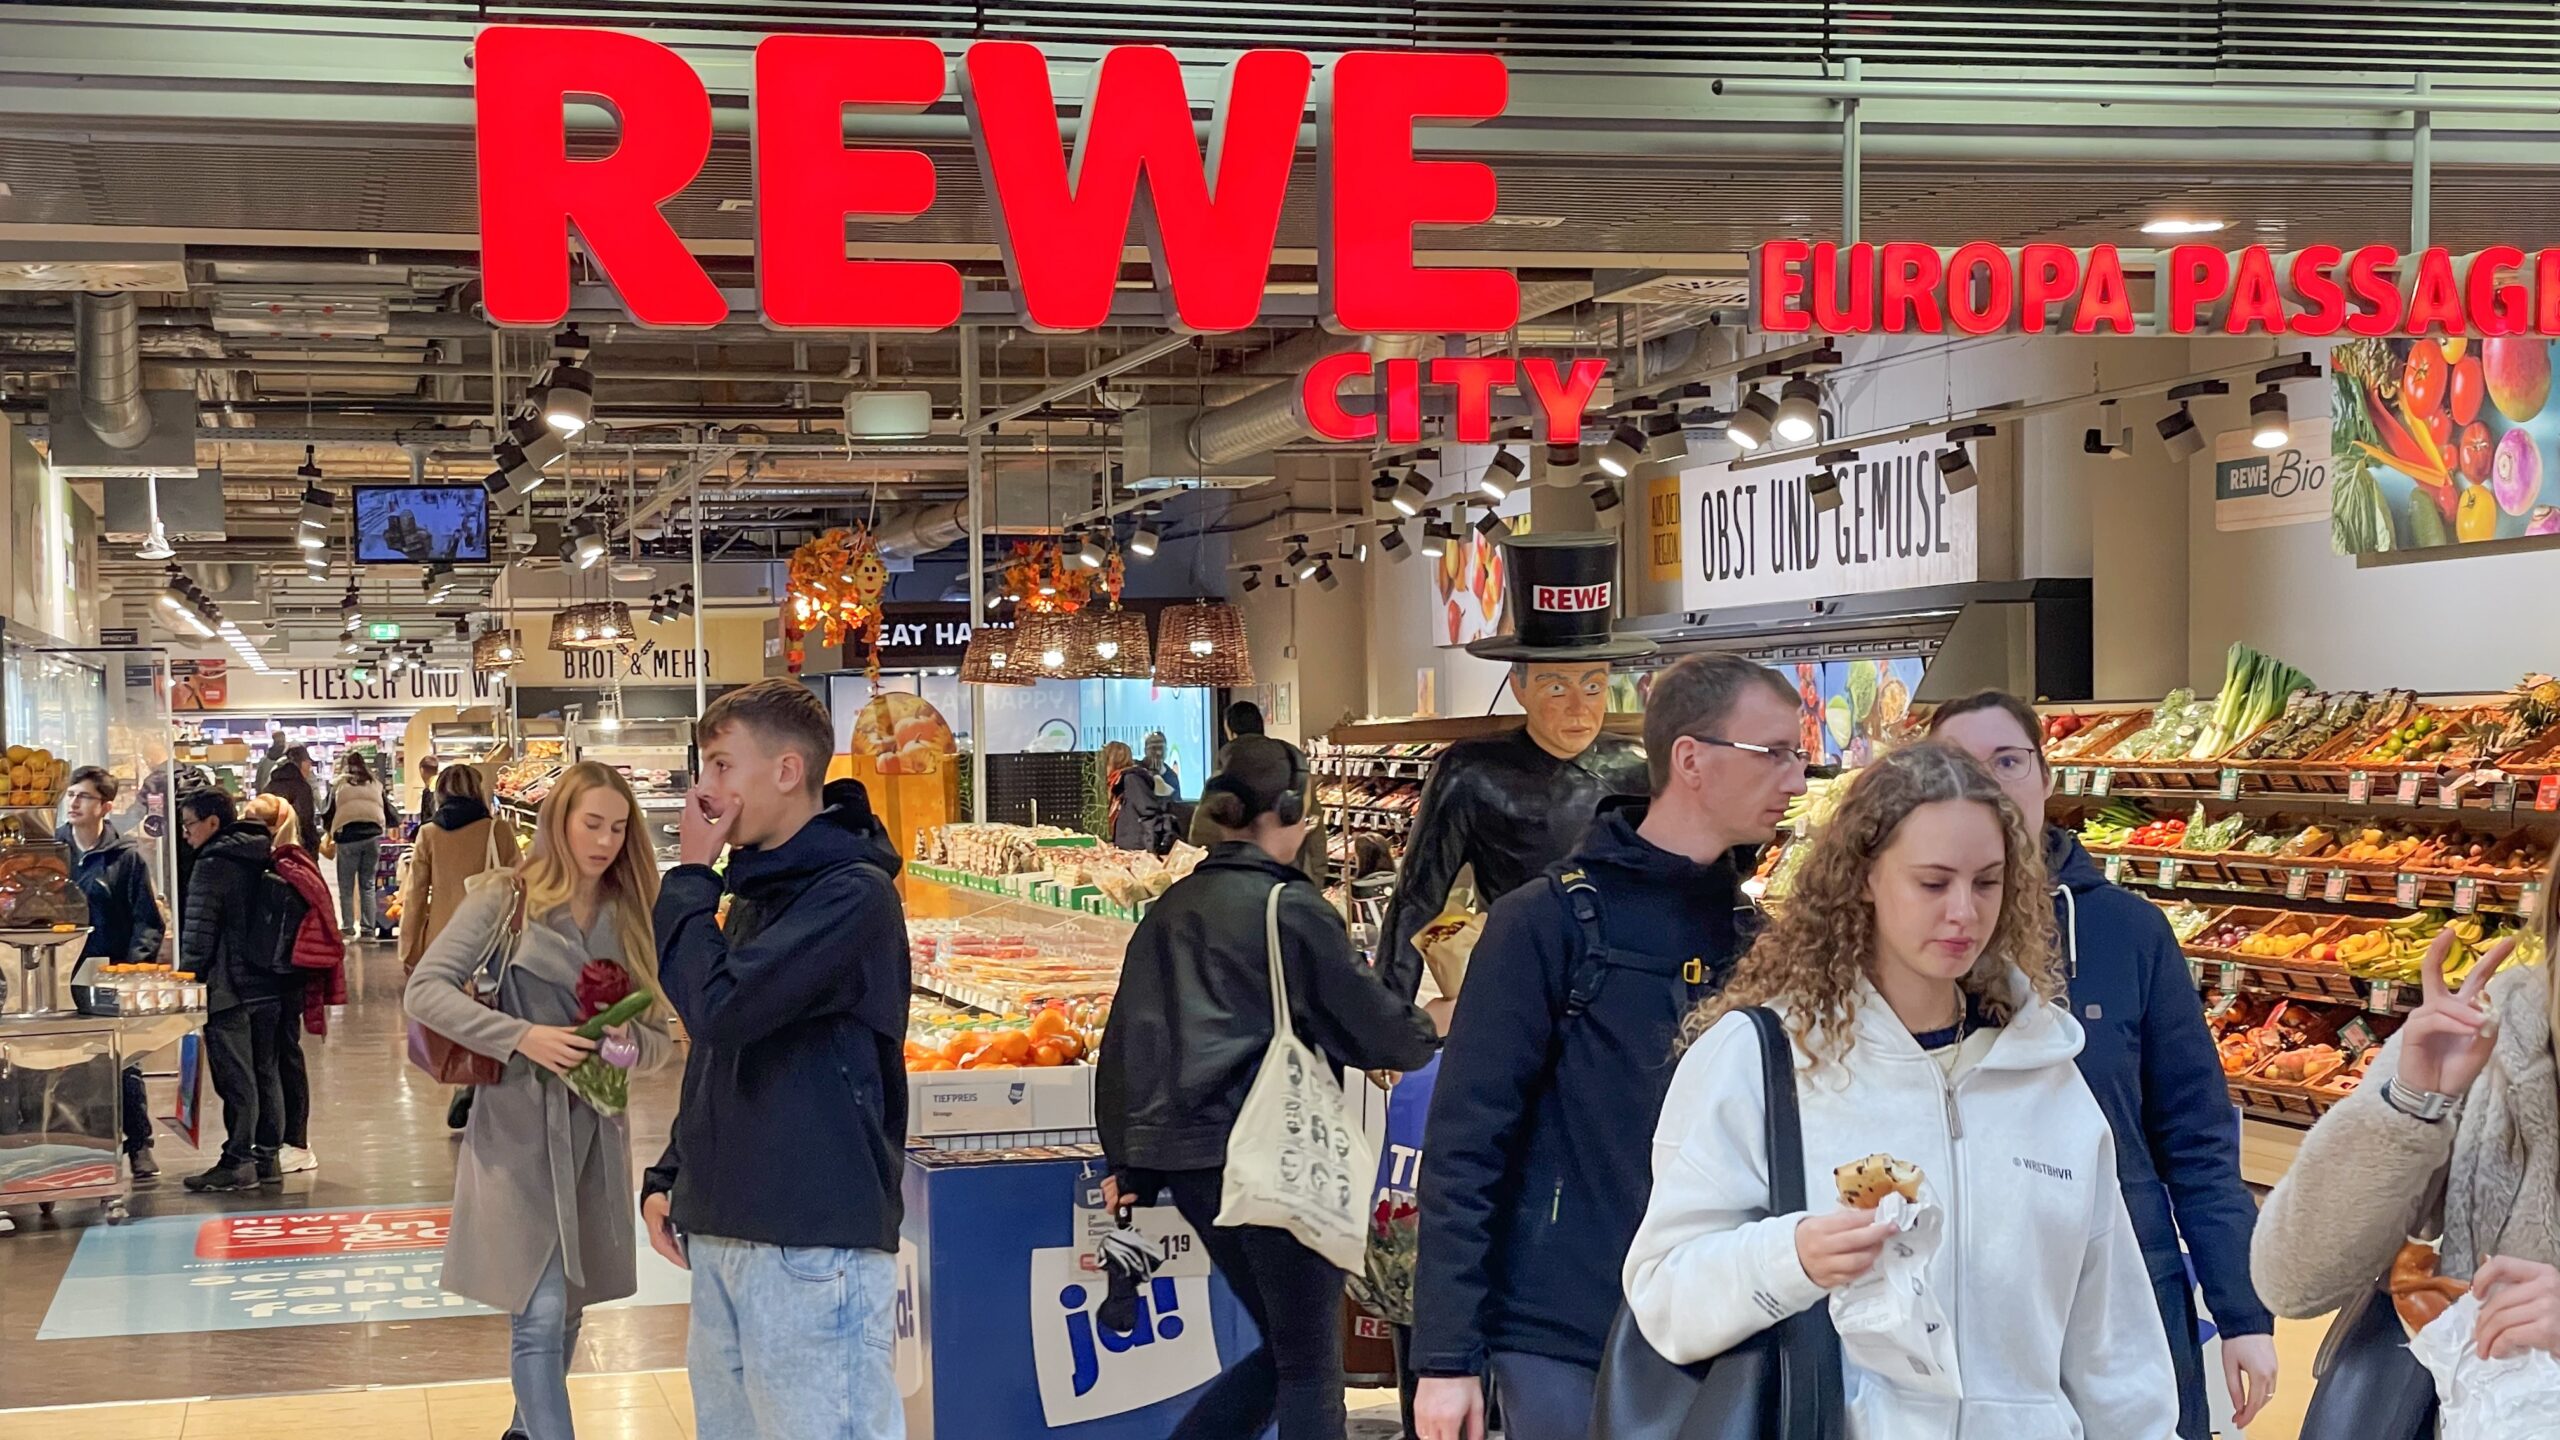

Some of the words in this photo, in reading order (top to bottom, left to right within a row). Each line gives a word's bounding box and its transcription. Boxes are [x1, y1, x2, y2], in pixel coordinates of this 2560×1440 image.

[474, 25, 1520, 332] REWE
[1760, 241, 2135, 334] EUROPA
[1303, 352, 1609, 443] CITY
[2230, 465, 2267, 490] REWE
[2271, 449, 2325, 498] Bio
[1701, 484, 1757, 582] OBST
[1771, 474, 1819, 574] UND
[1834, 438, 1951, 566] GEMÜSE
[1538, 585, 1607, 610] REWE
[875, 623, 927, 646] EAT
[565, 650, 614, 679] BROT
[630, 653, 641, 675] &
[654, 649, 710, 678] MEHR
[300, 668, 396, 699] FLEISCH
[411, 667, 458, 698] UND
[933, 1093, 978, 1103] TIEFPREIS
[2022, 1158, 2073, 1181] WRSTBHVR
[231, 1219, 436, 1239] Scan
[233, 1214, 350, 1226] REWE
[189, 1262, 444, 1286] scann
[229, 1276, 445, 1301] zahl
[244, 1292, 466, 1318] ferti
